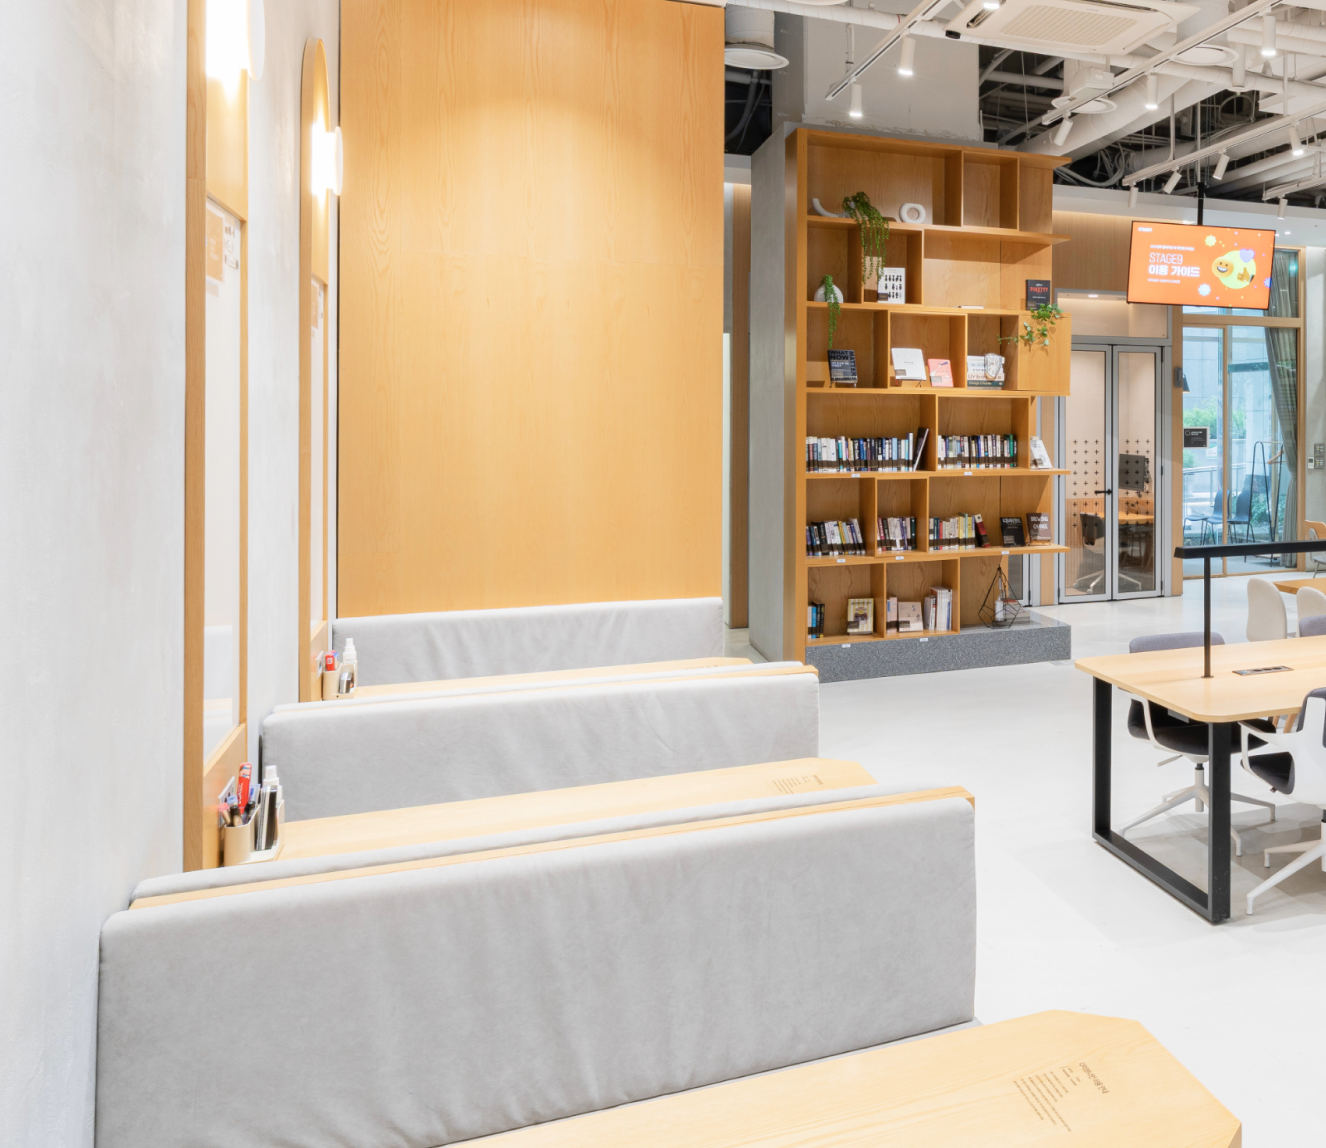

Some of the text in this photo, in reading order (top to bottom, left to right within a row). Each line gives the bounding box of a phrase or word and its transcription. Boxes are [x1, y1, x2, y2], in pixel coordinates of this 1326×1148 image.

[1149, 252, 1183, 265] STAGE9
[1148, 264, 1200, 278] 이용 가이드
